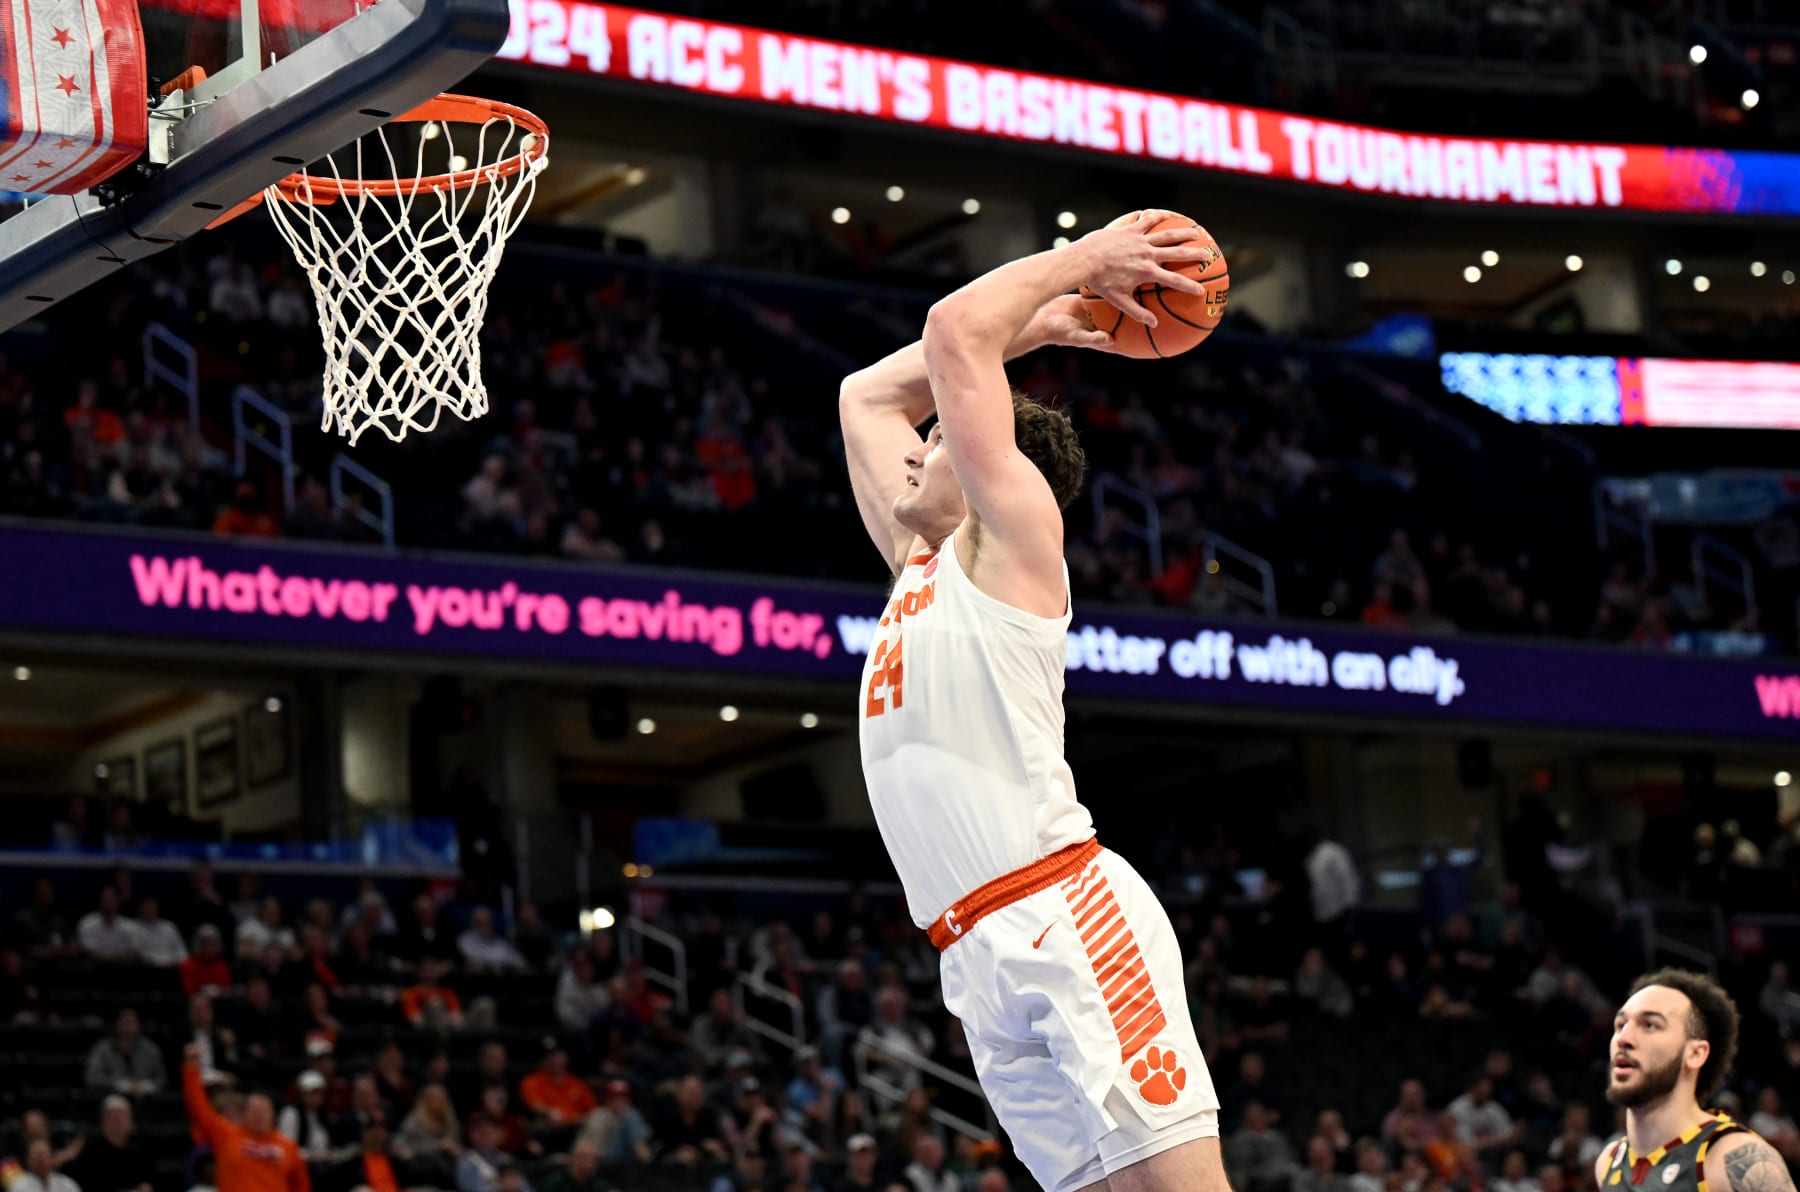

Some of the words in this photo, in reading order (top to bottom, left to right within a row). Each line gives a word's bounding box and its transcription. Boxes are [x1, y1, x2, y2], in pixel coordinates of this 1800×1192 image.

[626, 14, 745, 93] ACC
[757, 34, 933, 122] MEN'S
[944, 64, 1274, 173] BASKETBALL
[1281, 117, 1628, 206] TOURNAMENT
[129, 553, 398, 622] Whatever
[406, 580, 571, 636] you're
[577, 589, 744, 657] saving
[749, 596, 834, 659] for,
[1168, 628, 1235, 680] off
[1235, 633, 1330, 688] with
[1331, 650, 1387, 692] an
[1387, 645, 1467, 706] ally,
[866, 633, 904, 718] 24
[944, 909, 962, 936] C
